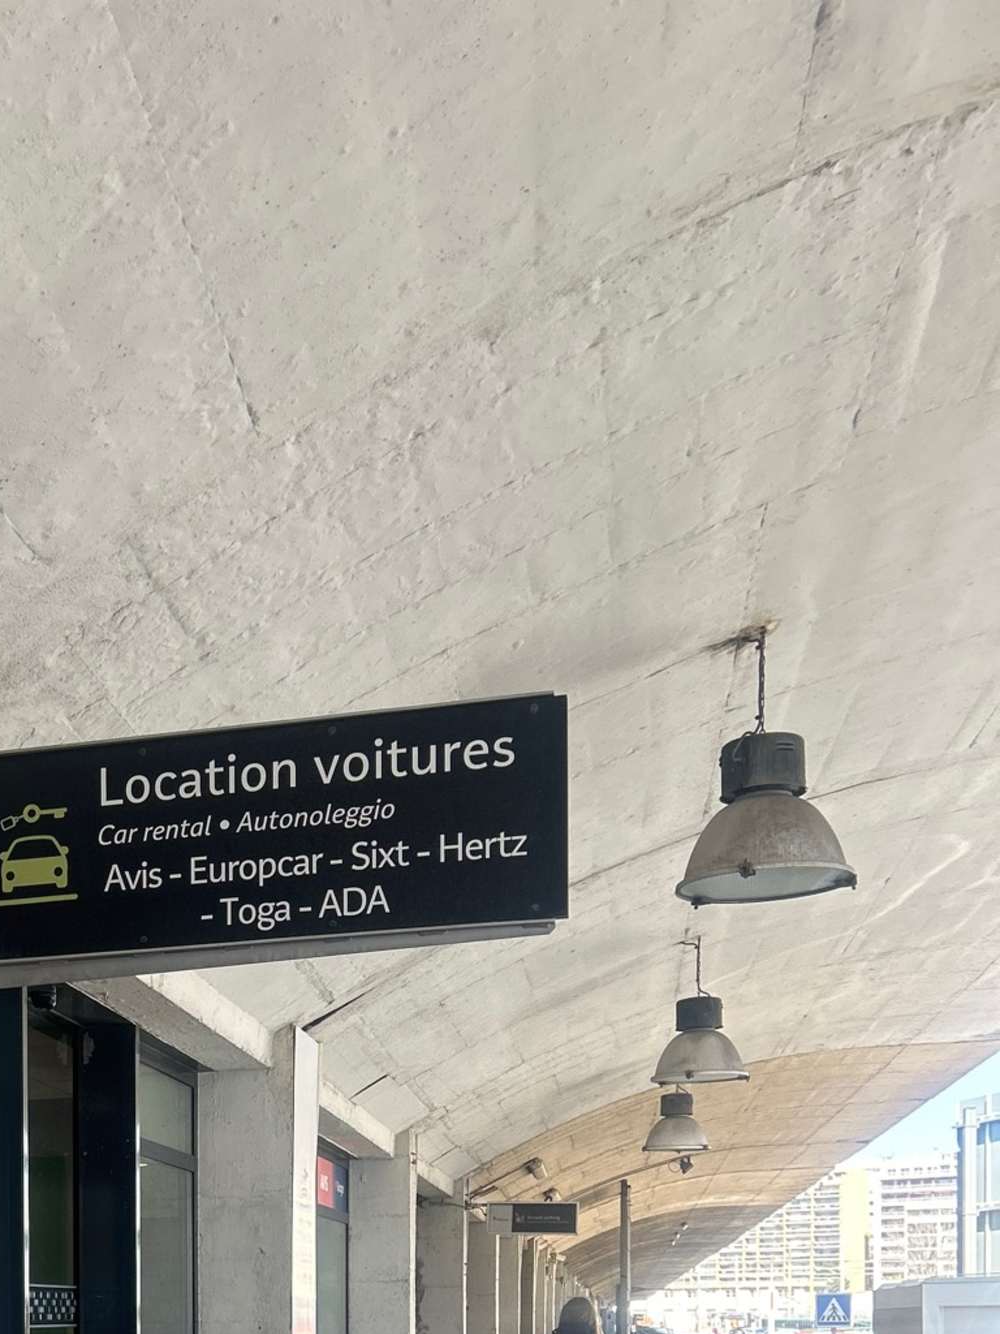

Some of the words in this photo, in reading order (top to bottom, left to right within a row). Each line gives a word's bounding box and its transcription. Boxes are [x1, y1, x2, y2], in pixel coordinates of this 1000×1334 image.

[100, 752, 297, 807] Location
[313, 735, 516, 785] voitures
[98, 824, 138, 846] Car
[142, 815, 212, 843] rental
[235, 798, 396, 833] Autonoleggio
[103, 860, 163, 893] Avis
[189, 852, 324, 888] Europcar
[351, 839, 410, 871] Sixt
[439, 831, 528, 864] Hertz
[219, 897, 292, 932] Toga
[318, 884, 391, 919] ADA
